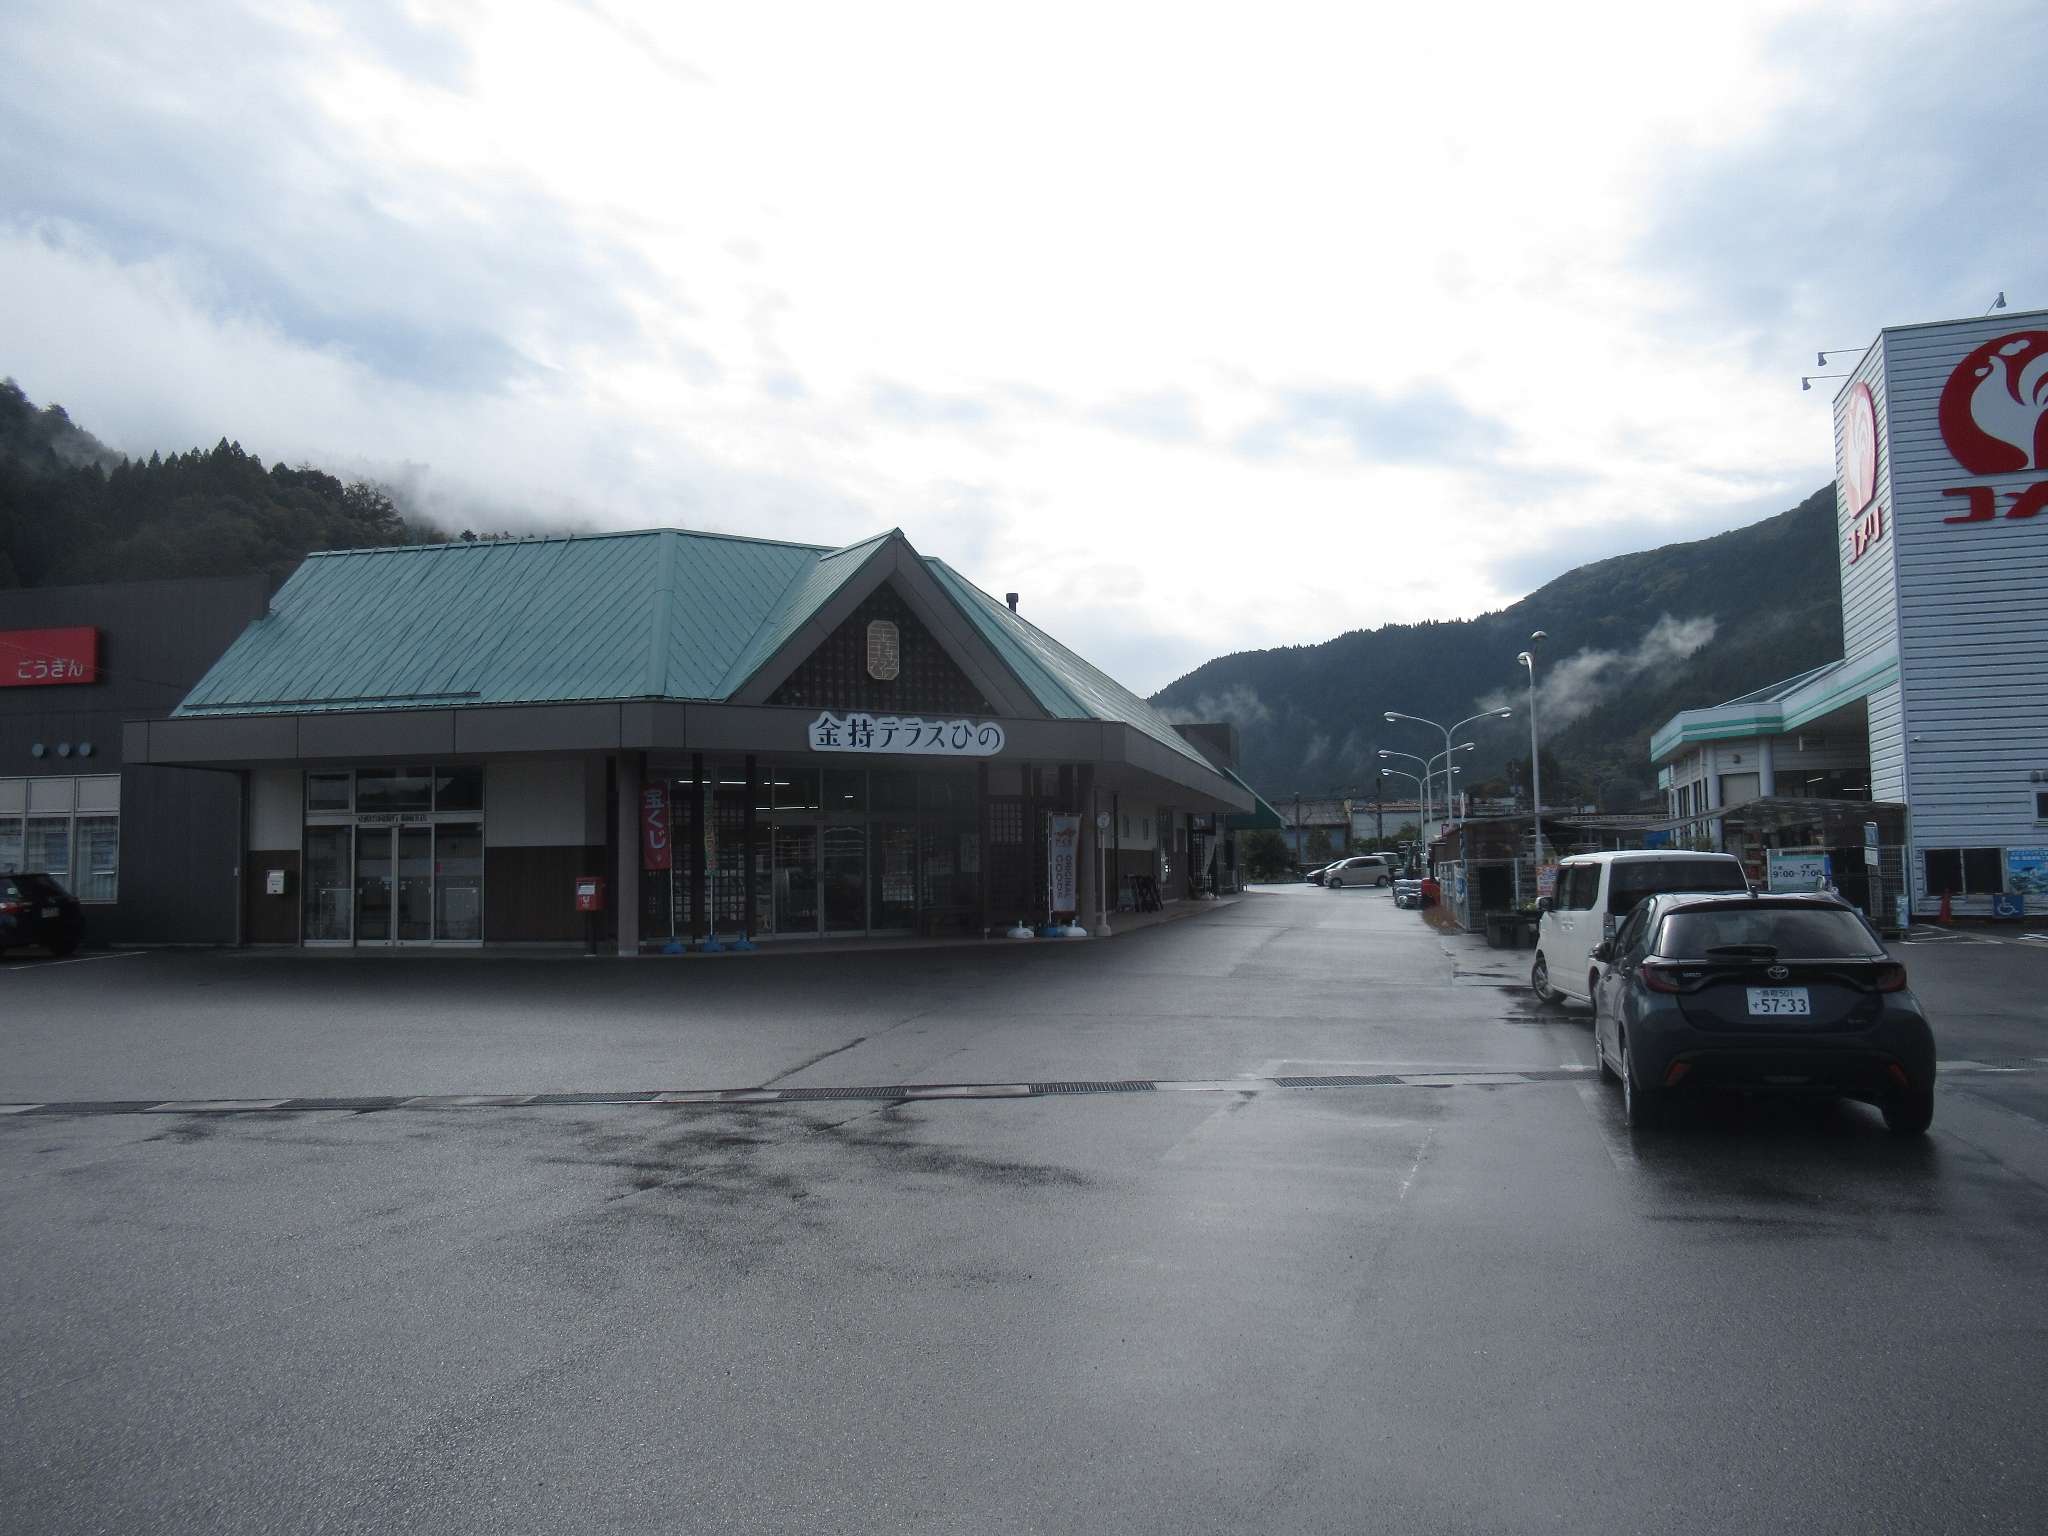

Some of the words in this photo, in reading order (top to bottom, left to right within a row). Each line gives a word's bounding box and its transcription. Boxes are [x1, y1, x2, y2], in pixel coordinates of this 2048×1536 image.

[1847, 505, 1883, 565] コメリ
[815, 717, 1001, 750] 金持テラスひの
[644, 789, 666, 849] 宝くじ
